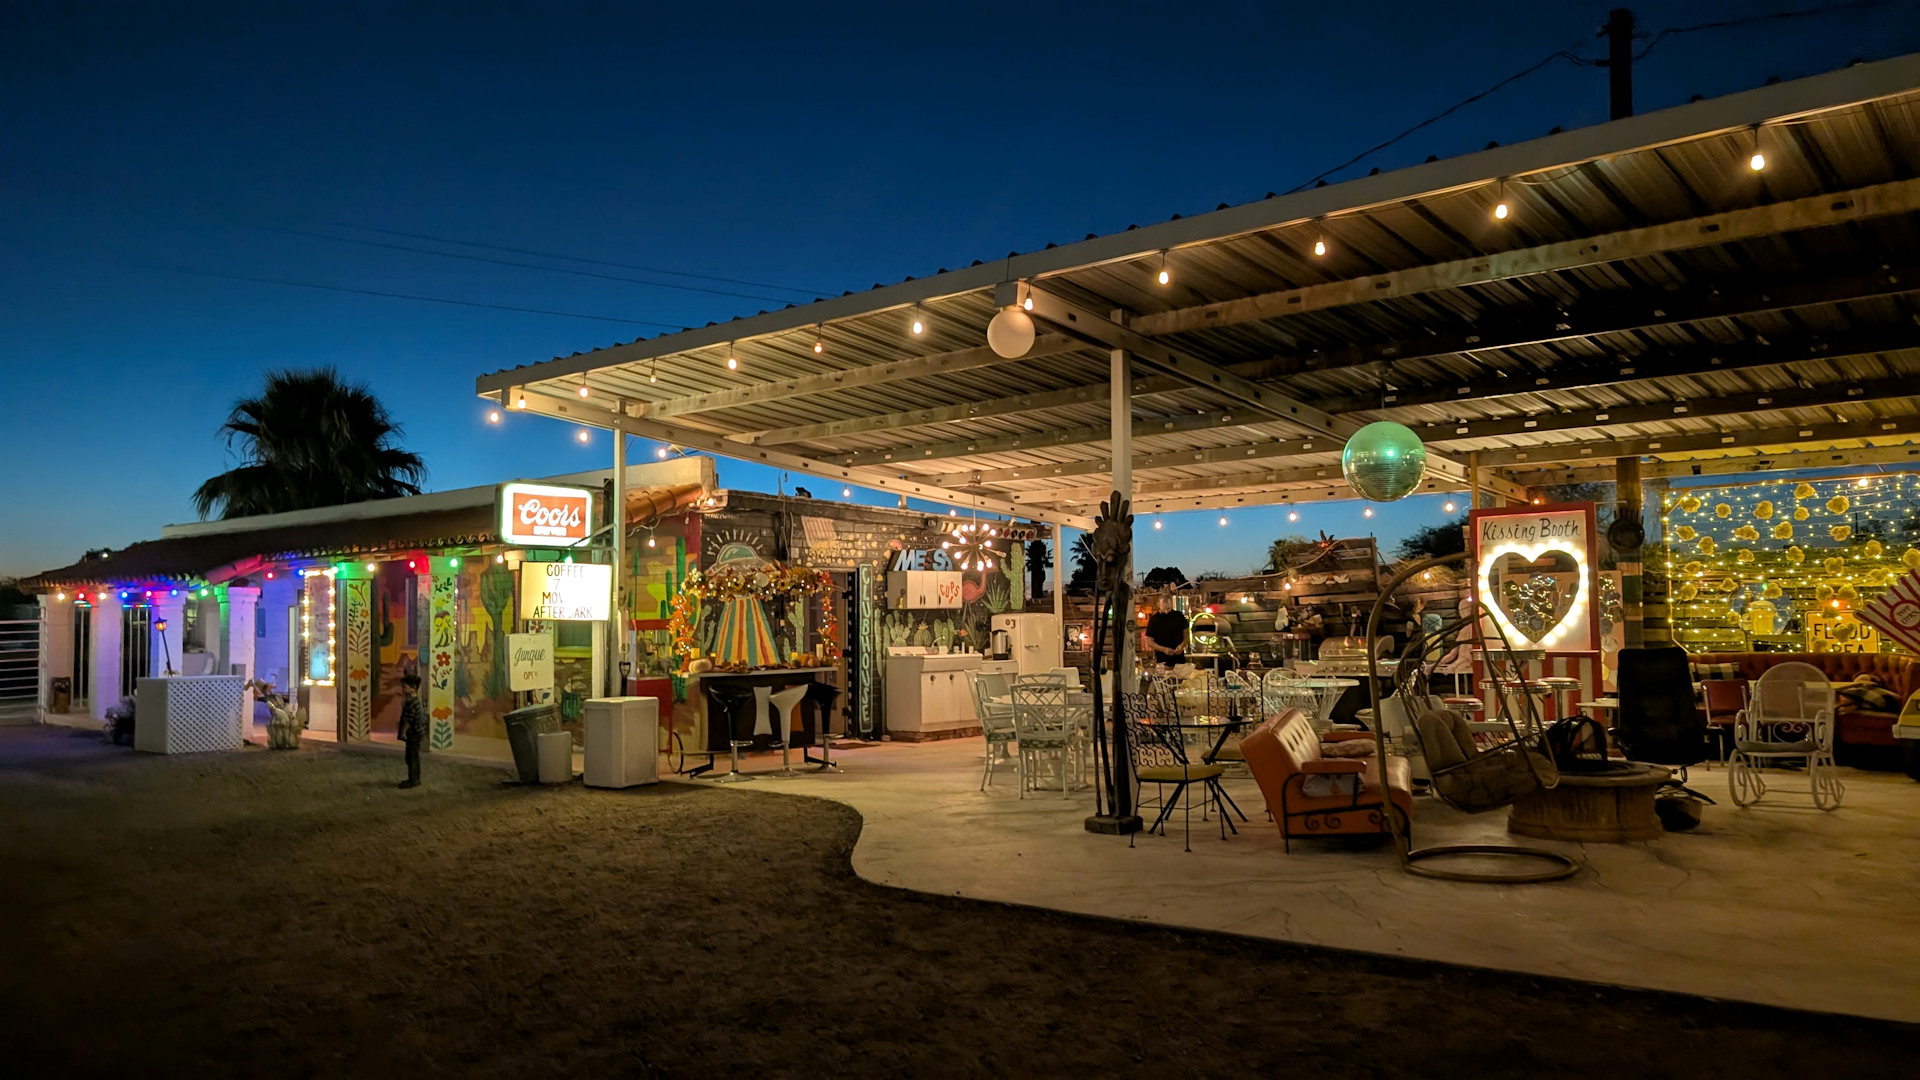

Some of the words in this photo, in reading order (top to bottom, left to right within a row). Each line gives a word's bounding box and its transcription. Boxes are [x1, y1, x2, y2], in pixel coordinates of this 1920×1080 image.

[518, 498, 581, 528] Coors
[1482, 521, 1536, 542] Kissing
[1539, 517, 1582, 538] Booth
[546, 564, 585, 578] COFFEE
[939, 581, 960, 598] CUPS
[533, 605, 565, 619] AFTER
[1814, 623, 1870, 640] FLD
[861, 567, 872, 722] CLUBHOUSE
[1826, 644, 1865, 654] REA
